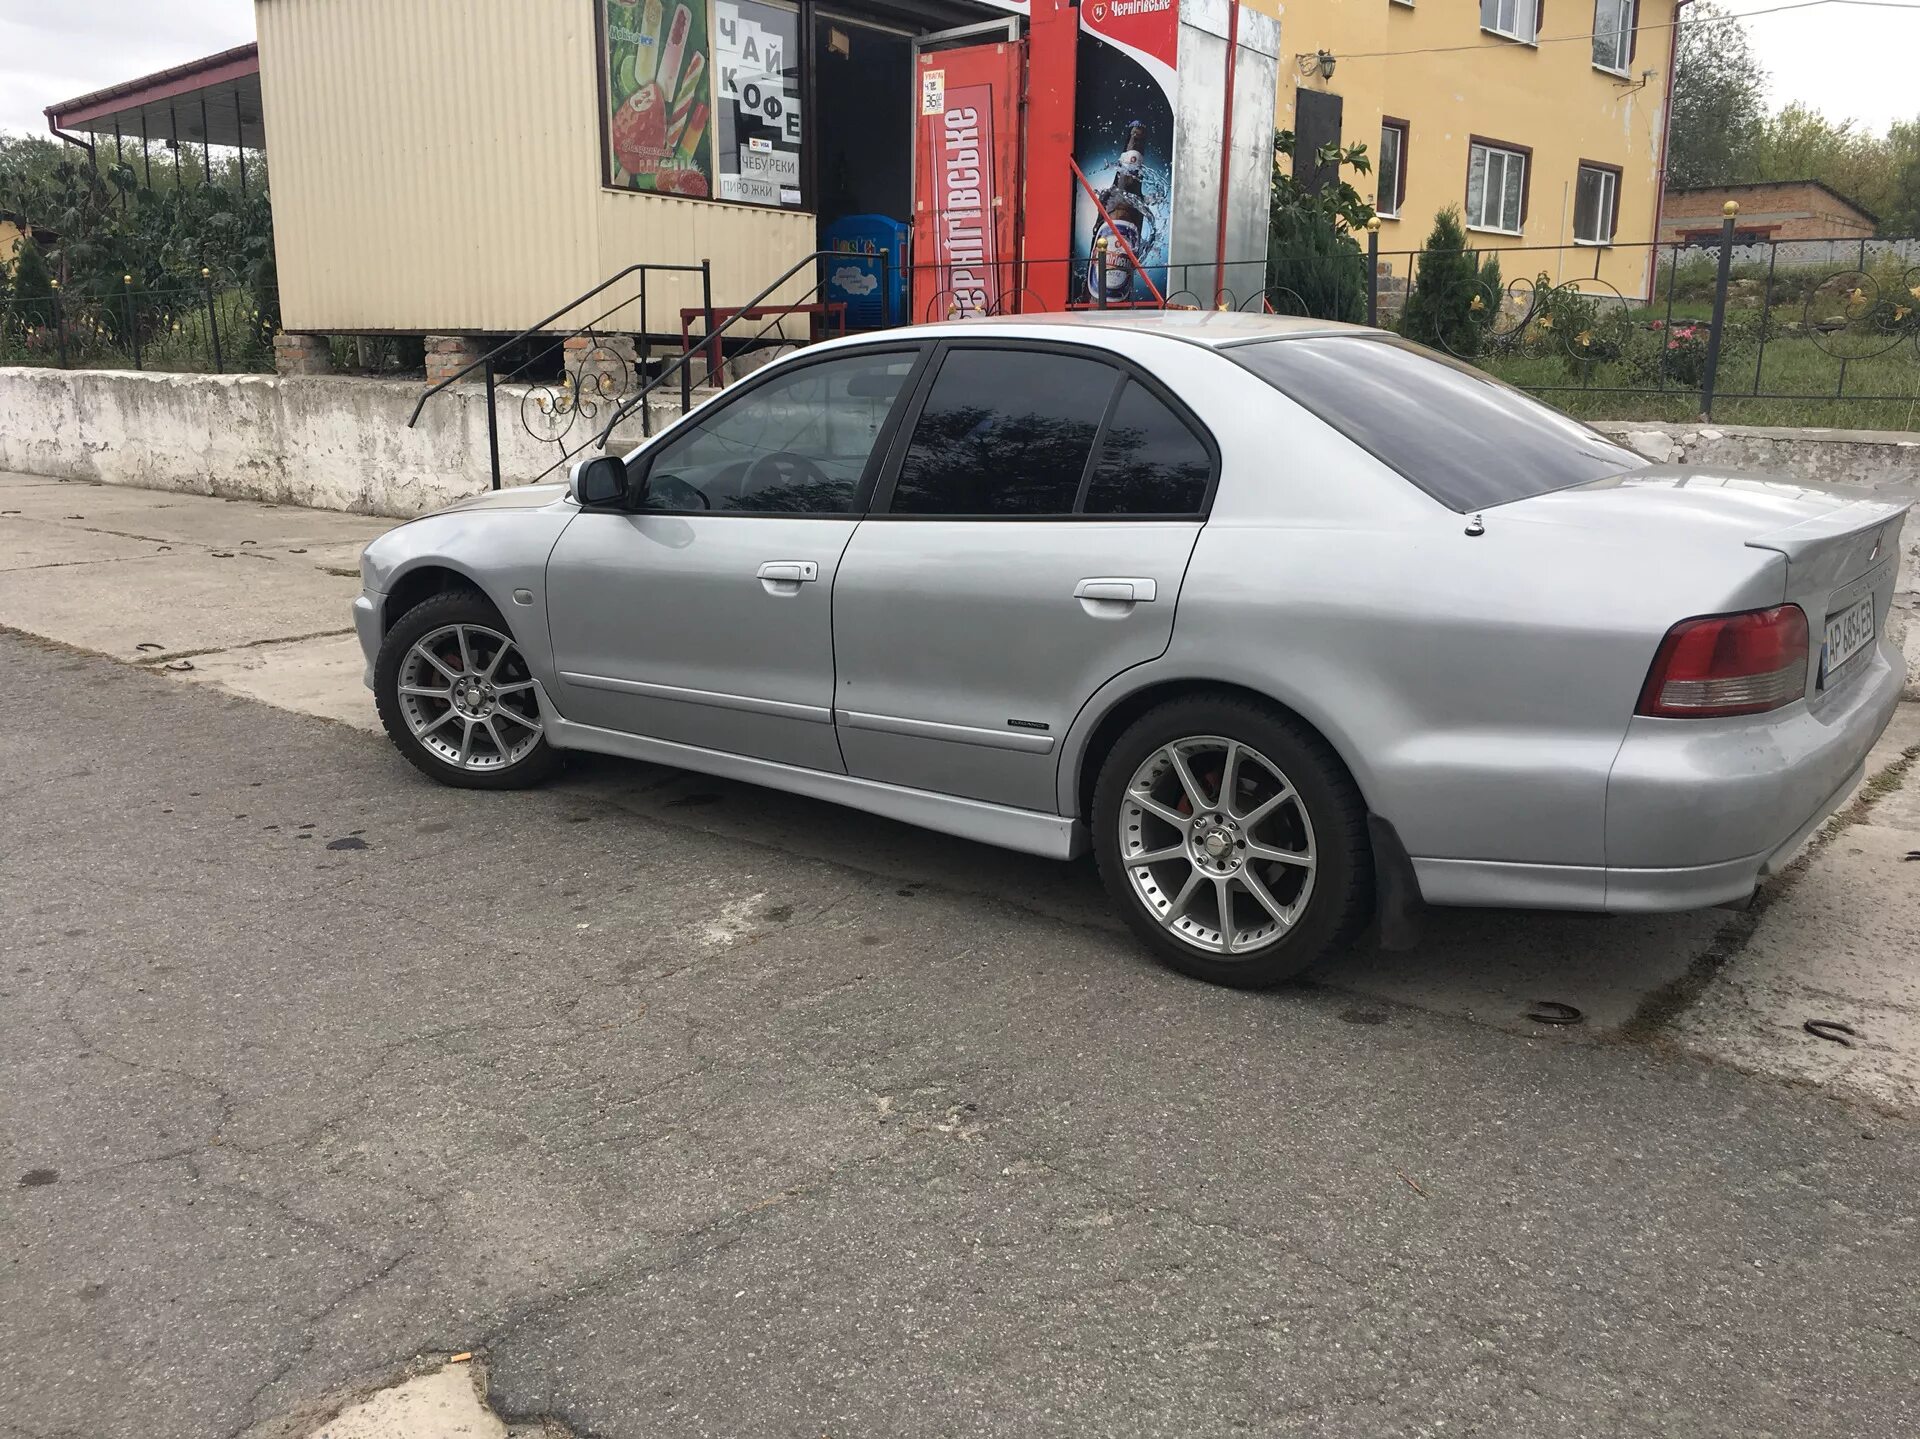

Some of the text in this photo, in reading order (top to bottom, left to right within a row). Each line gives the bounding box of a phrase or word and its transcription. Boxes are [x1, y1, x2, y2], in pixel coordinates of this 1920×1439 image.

[720, 17, 781, 76] ЧАЙ
[721, 66, 801, 137] КОФЕ
[760, 141, 769, 149] VISA
